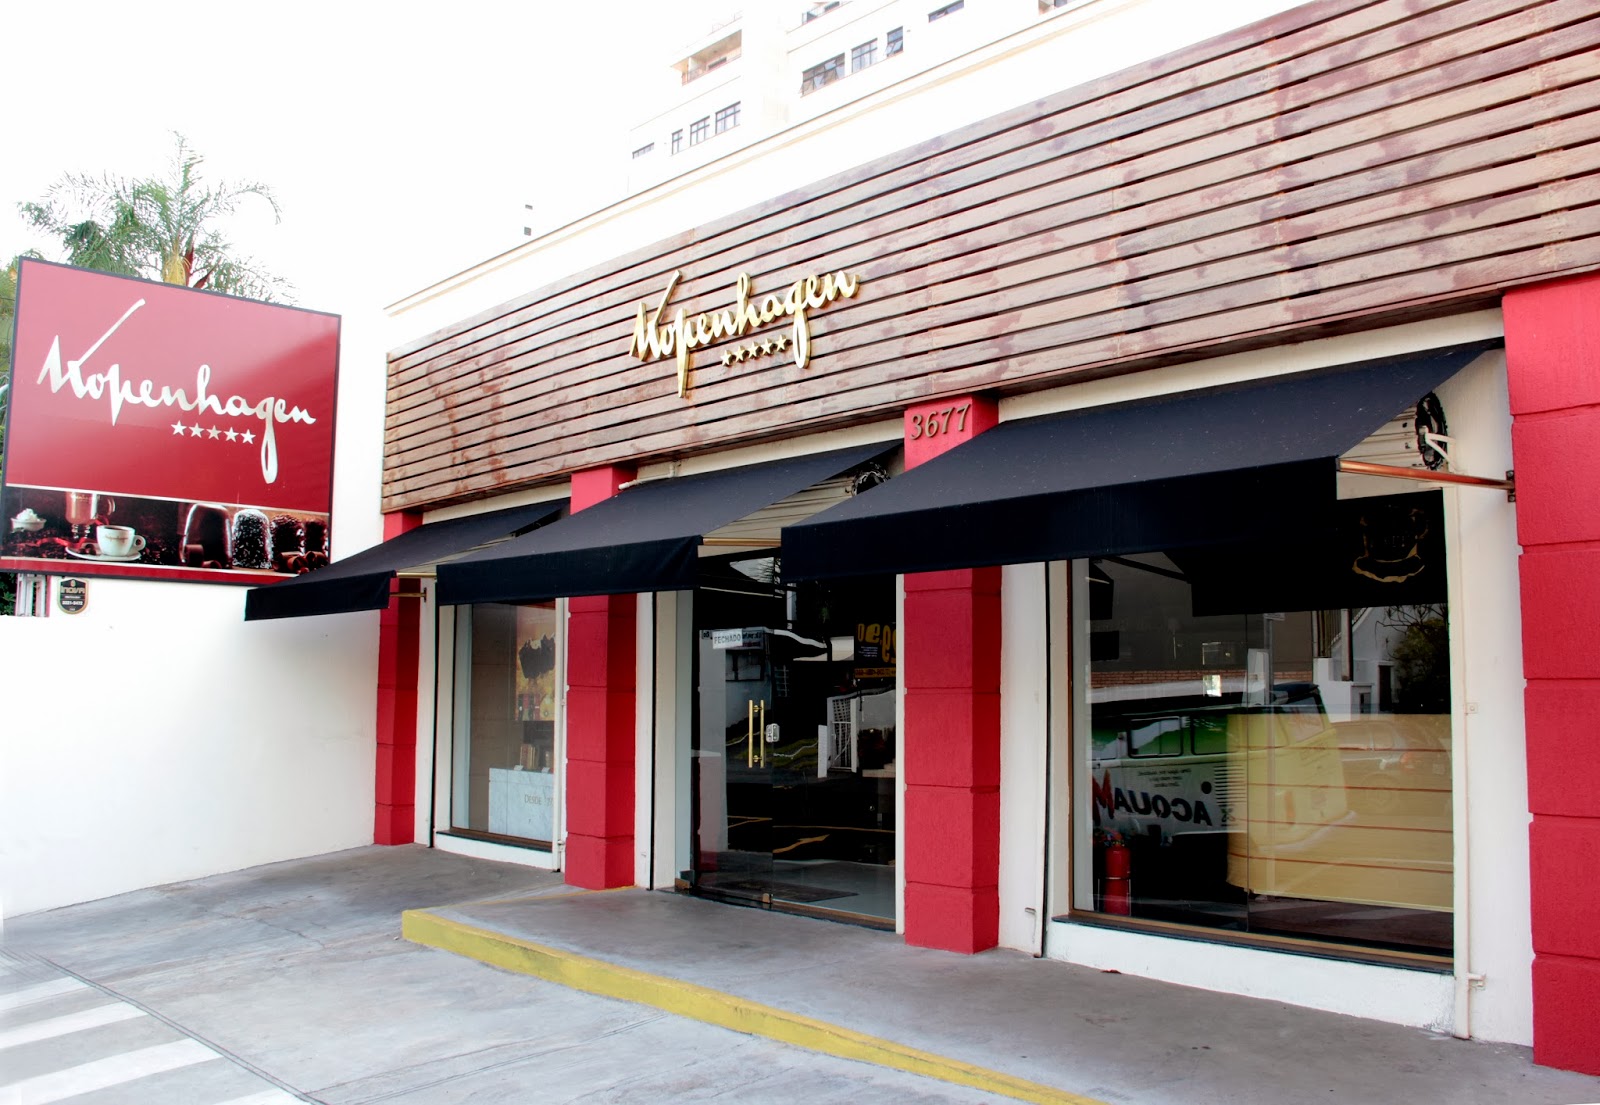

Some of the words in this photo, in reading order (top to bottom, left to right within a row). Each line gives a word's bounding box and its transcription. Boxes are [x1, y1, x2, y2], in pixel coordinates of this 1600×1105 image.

[36, 298, 317, 484] Kopenhagen
[629, 269, 860, 398] Kopenhagen
[909, 403, 972, 440] 3677
